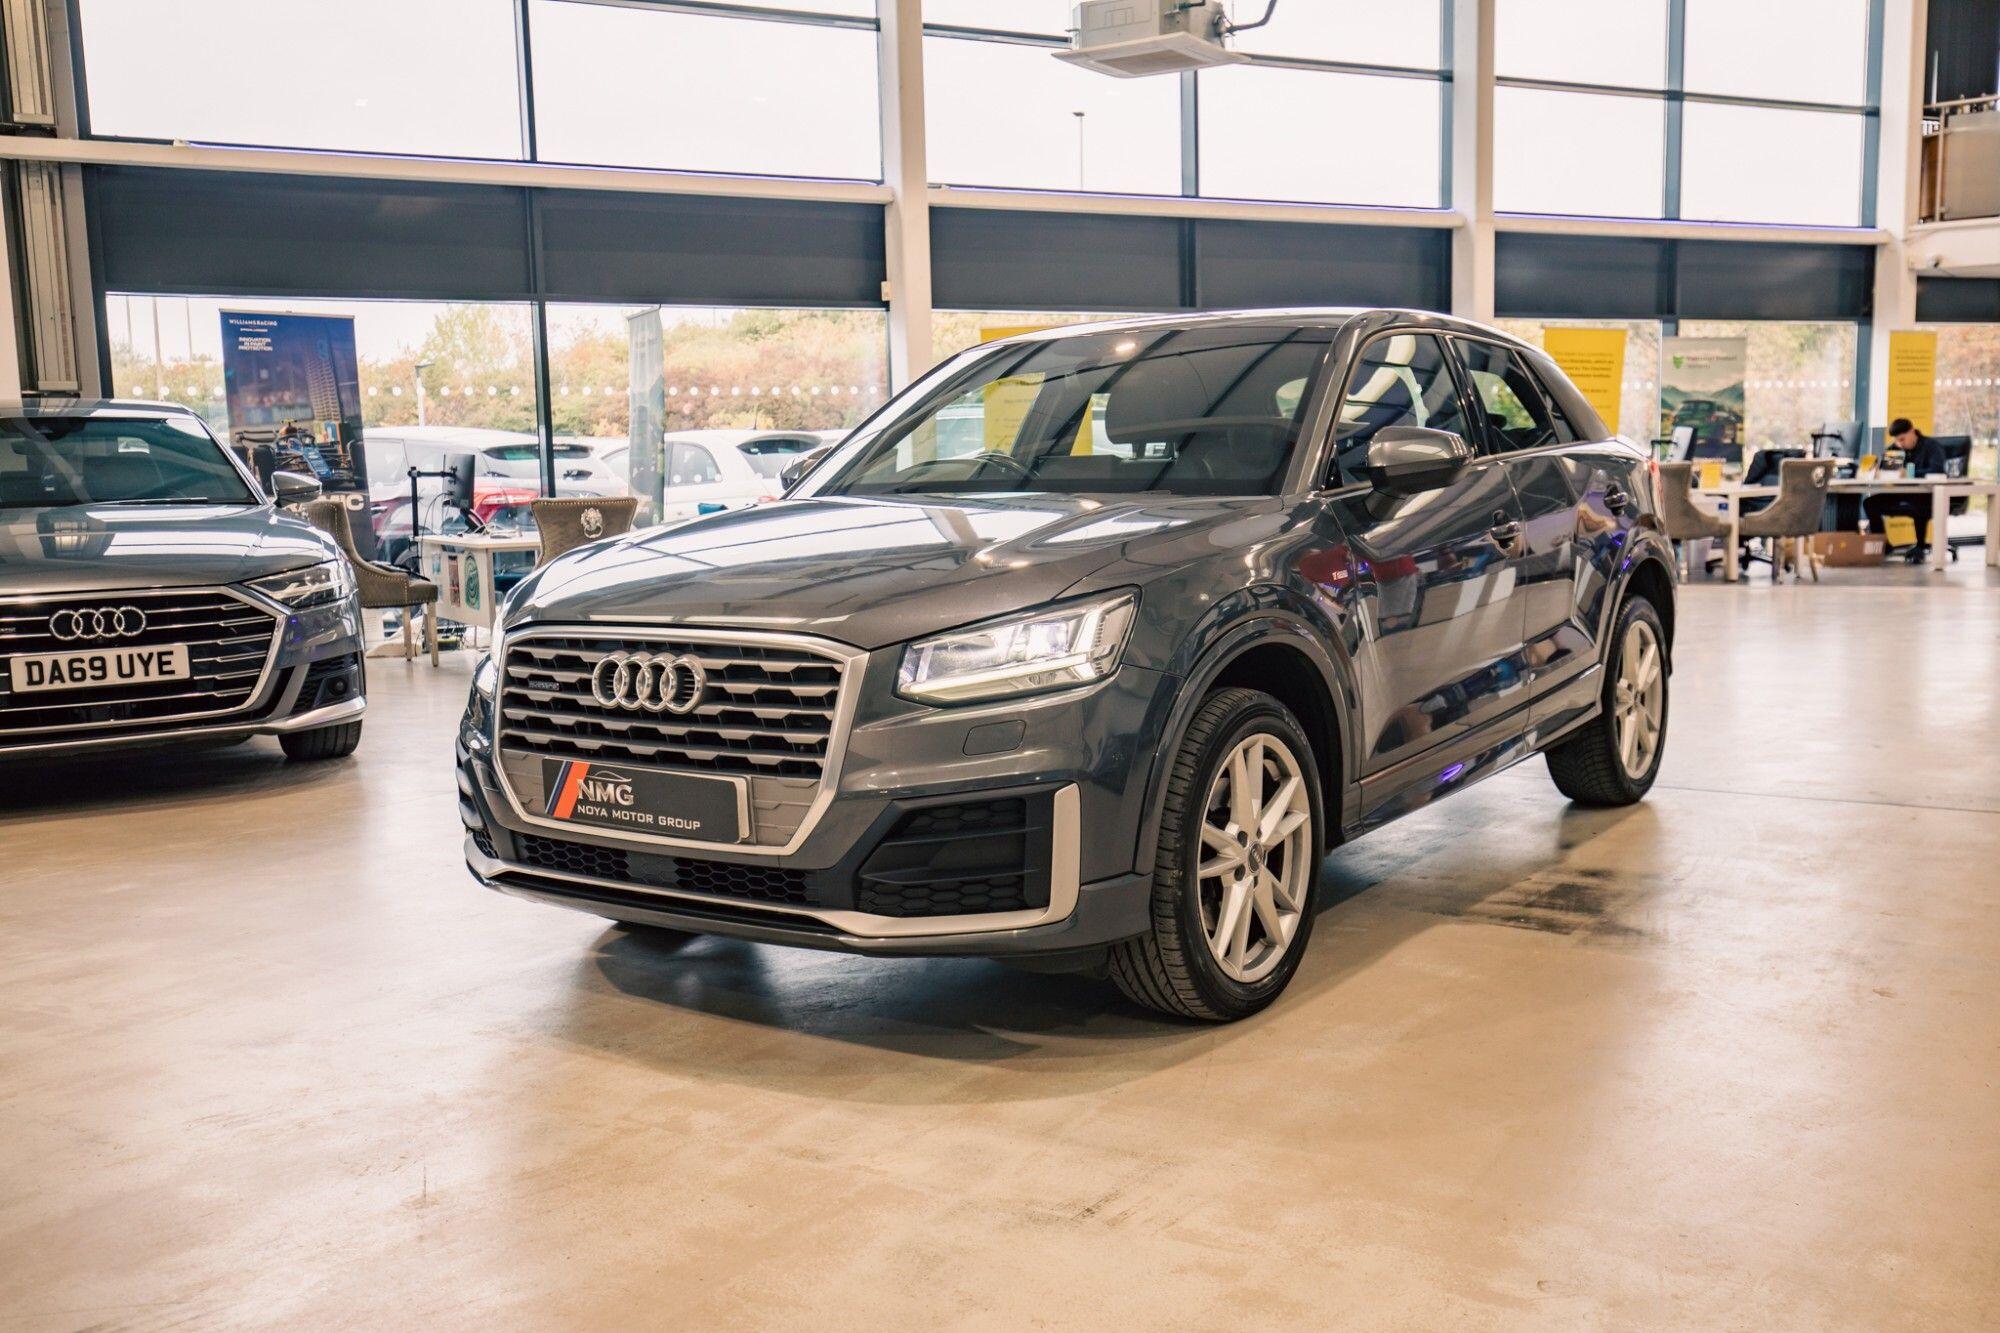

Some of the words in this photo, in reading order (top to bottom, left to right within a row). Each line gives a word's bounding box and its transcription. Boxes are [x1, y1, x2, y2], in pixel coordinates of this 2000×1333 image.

[25, 656, 108, 686] DA69
[117, 650, 176, 679] UYE
[577, 778, 634, 806] NMG
[577, 805, 608, 817] NOYA
[612, 810, 654, 824] MOTOR
[658, 816, 700, 830] GROUP
